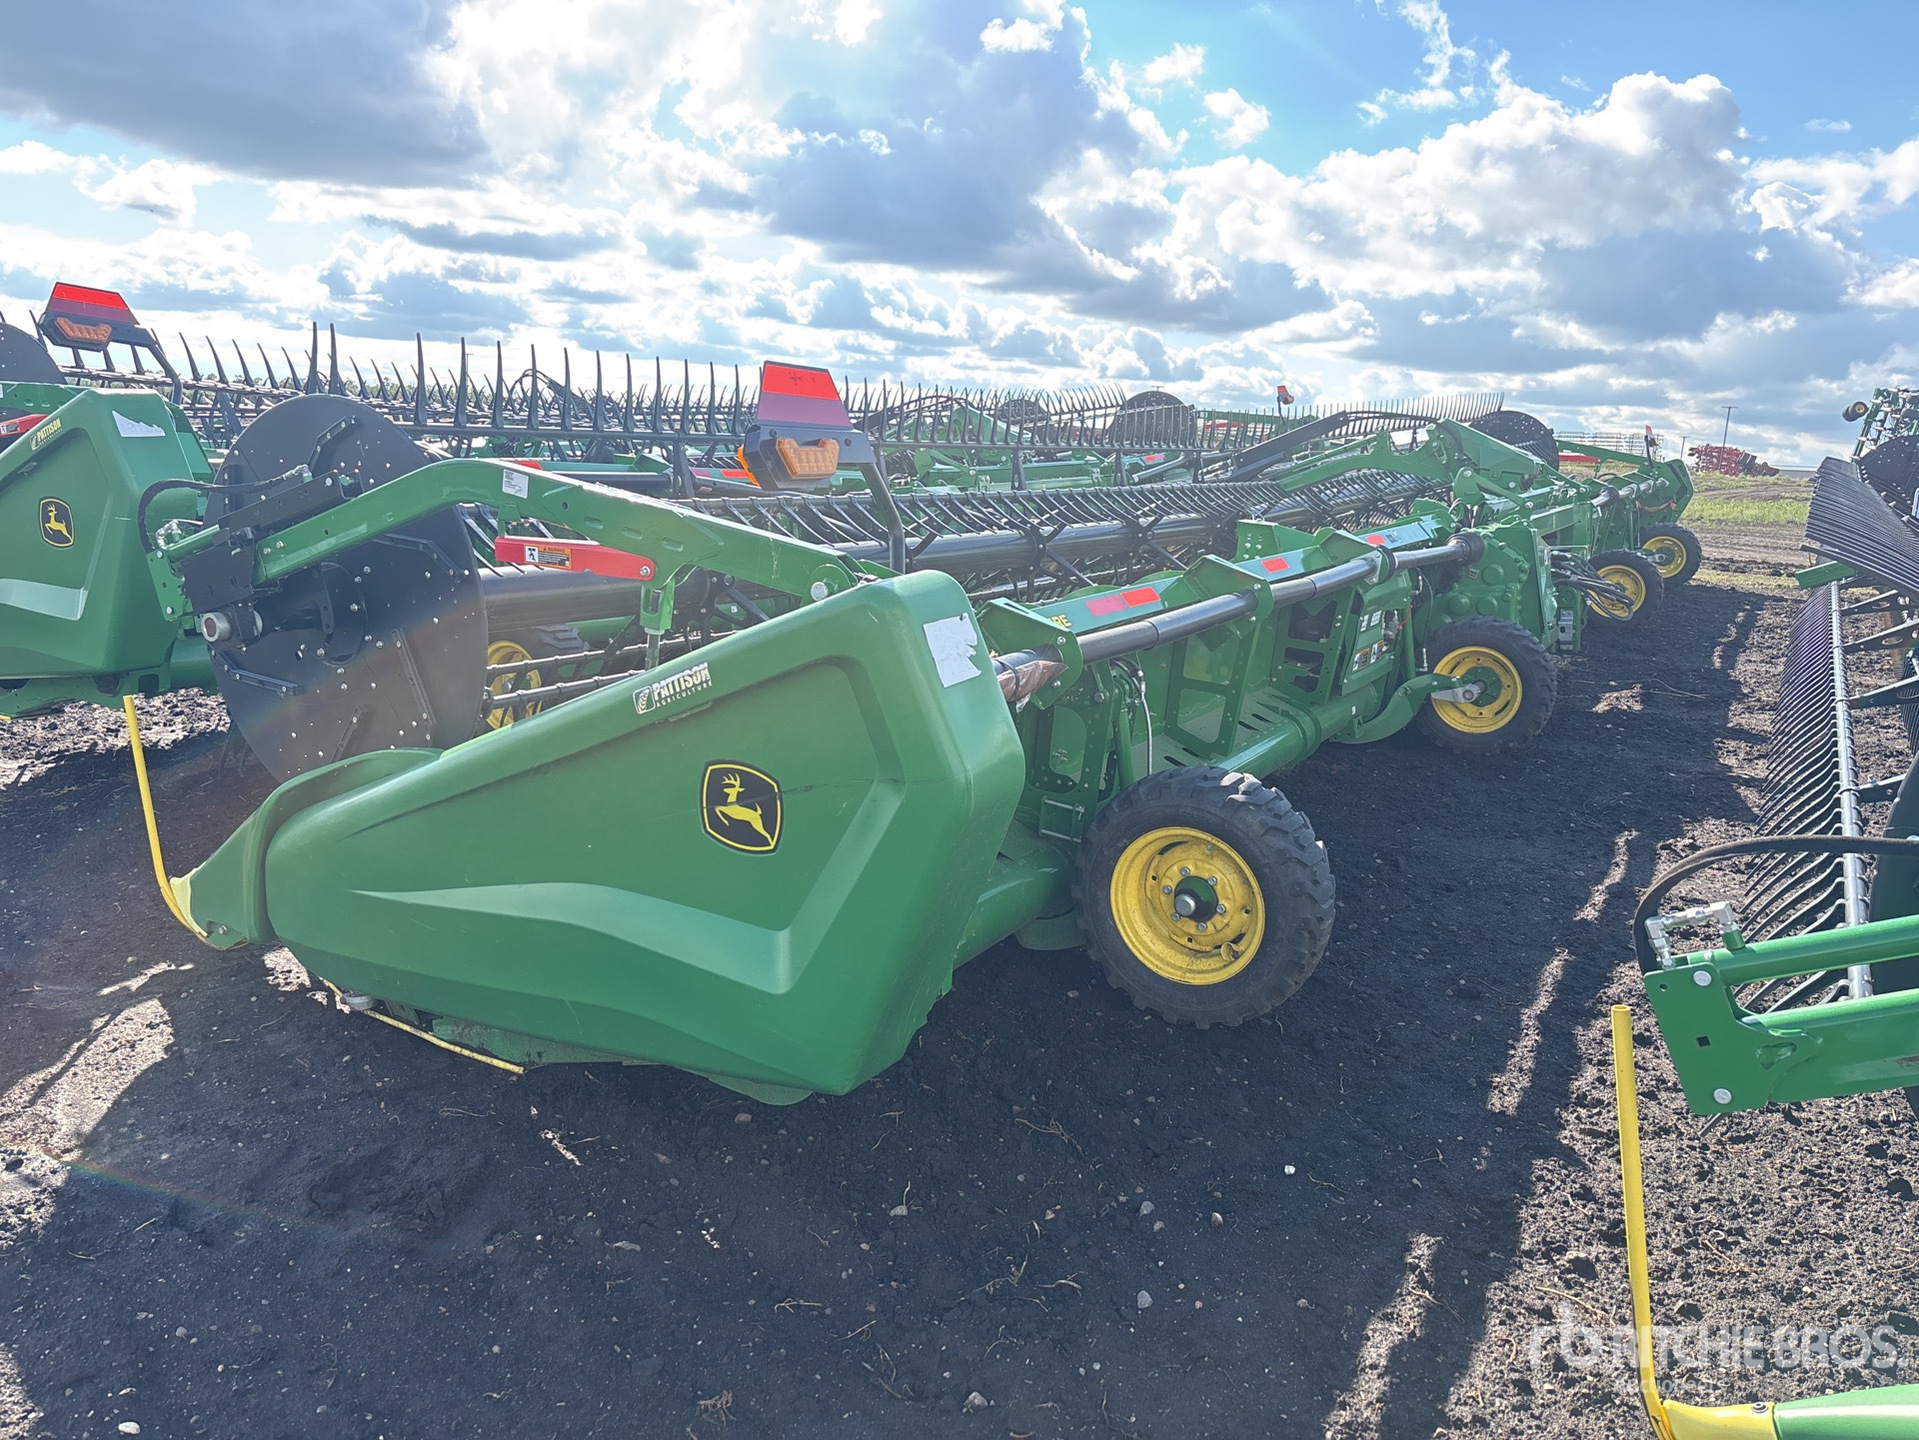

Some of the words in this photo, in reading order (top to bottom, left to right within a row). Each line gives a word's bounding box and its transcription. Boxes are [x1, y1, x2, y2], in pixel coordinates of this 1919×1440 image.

[37, 417, 61, 441] PATTISON
[652, 662, 711, 701] PATTISON
[656, 680, 712, 708] AGRICULTURE
